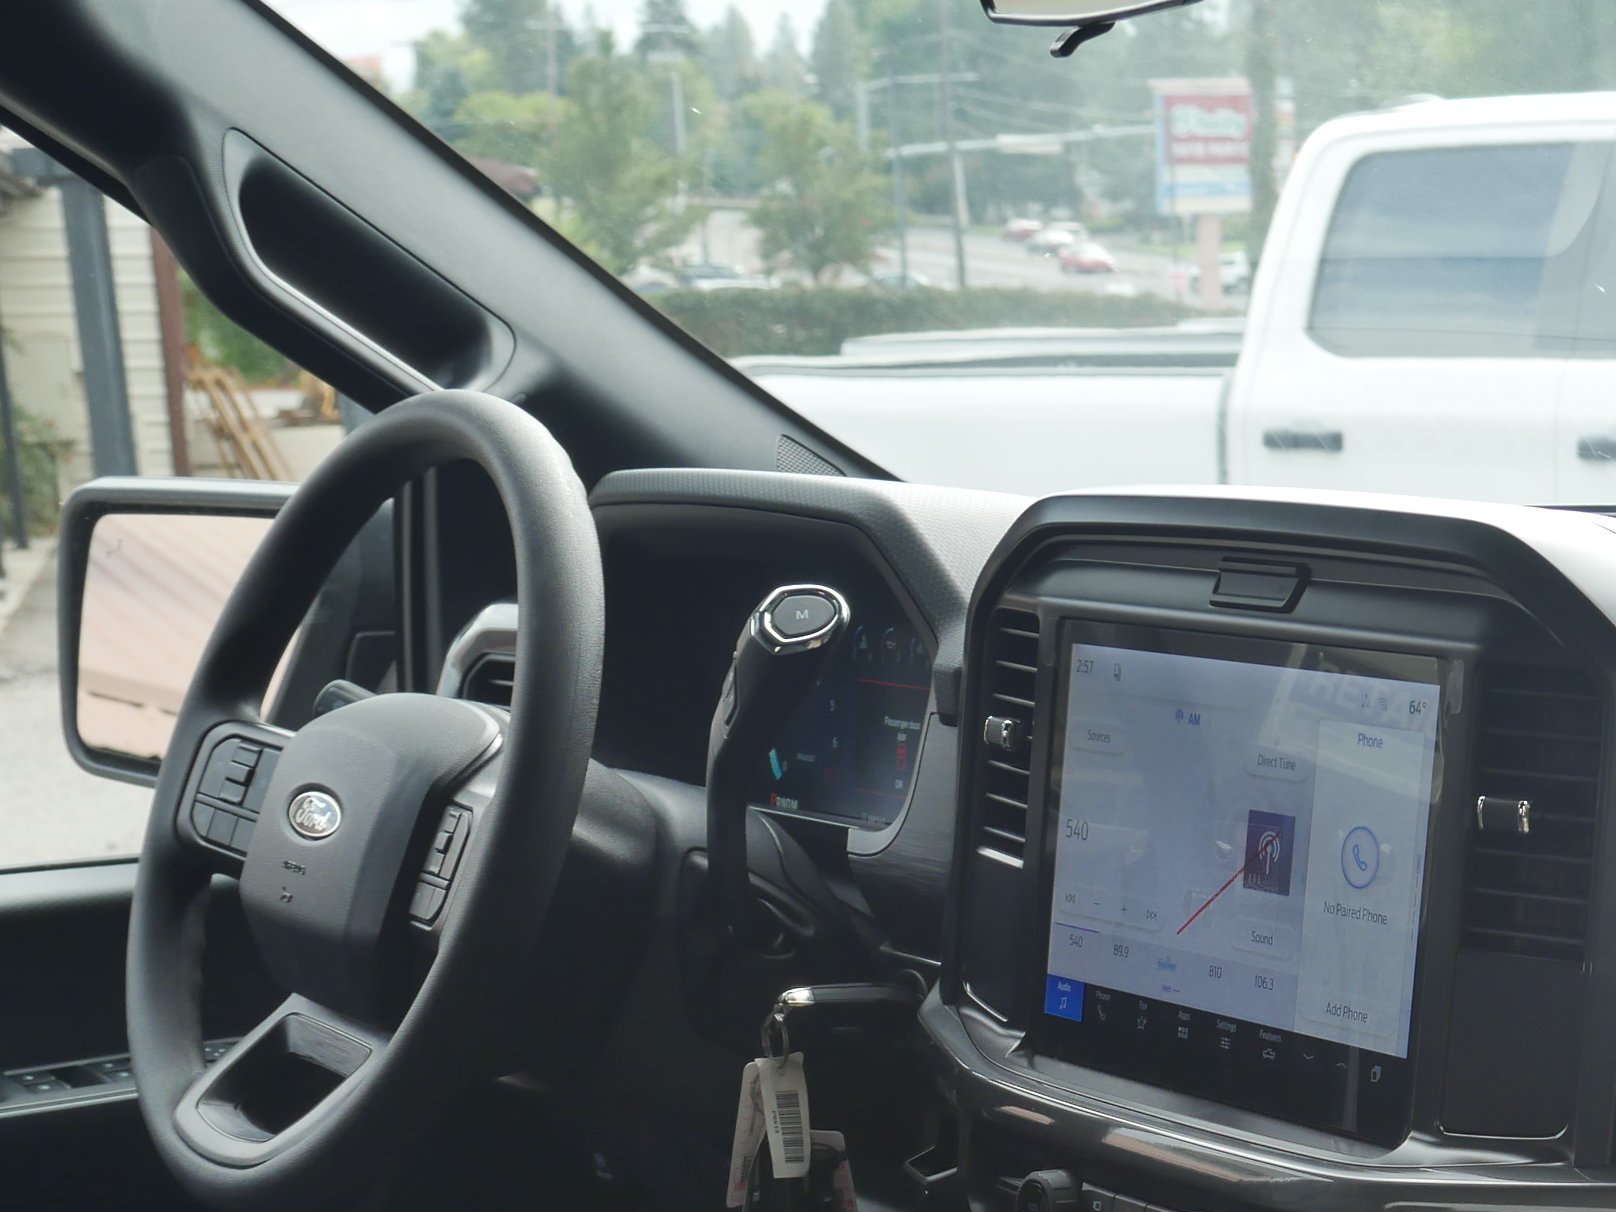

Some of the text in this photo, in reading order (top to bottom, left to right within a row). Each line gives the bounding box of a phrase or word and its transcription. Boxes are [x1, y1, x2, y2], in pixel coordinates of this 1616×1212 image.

[796, 609, 809, 620] M
[1076, 659, 1094, 674] 2:57
[1188, 713, 1200, 726] AM
[1087, 729, 1112, 743] Sources
[1357, 732, 1384, 749] Phone
[1257, 754, 1296, 771] Direct Tune
[1065, 818, 1089, 841] 540
[1324, 901, 1388, 926] No Paired Phone
[1251, 930, 1274, 946] Sound
[1069, 934, 1274, 991] 540 89.9 810 106.3
[1326, 1001, 1368, 1023] Add Phone
